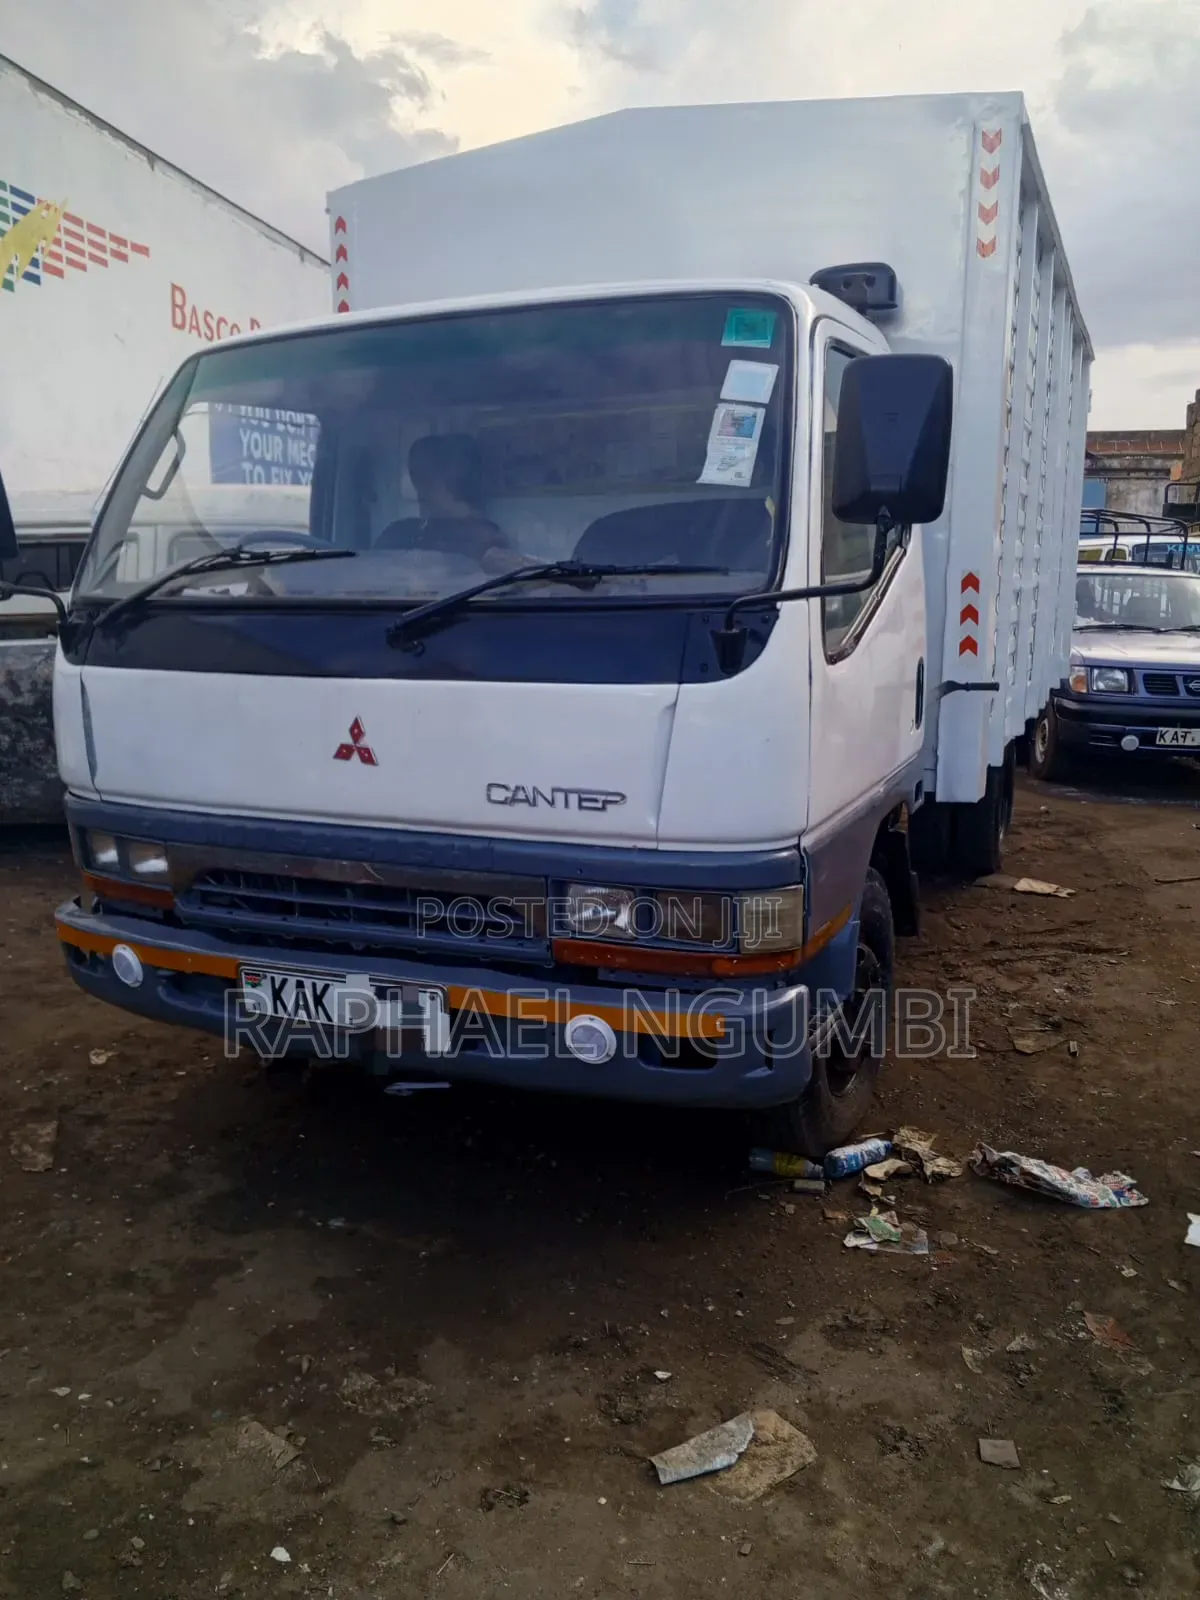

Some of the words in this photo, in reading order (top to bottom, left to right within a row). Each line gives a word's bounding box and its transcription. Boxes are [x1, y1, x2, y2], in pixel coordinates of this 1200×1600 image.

[239, 427, 283, 464] YOUR
[240, 461, 265, 484] TO
[269, 975, 334, 1023] KAK
